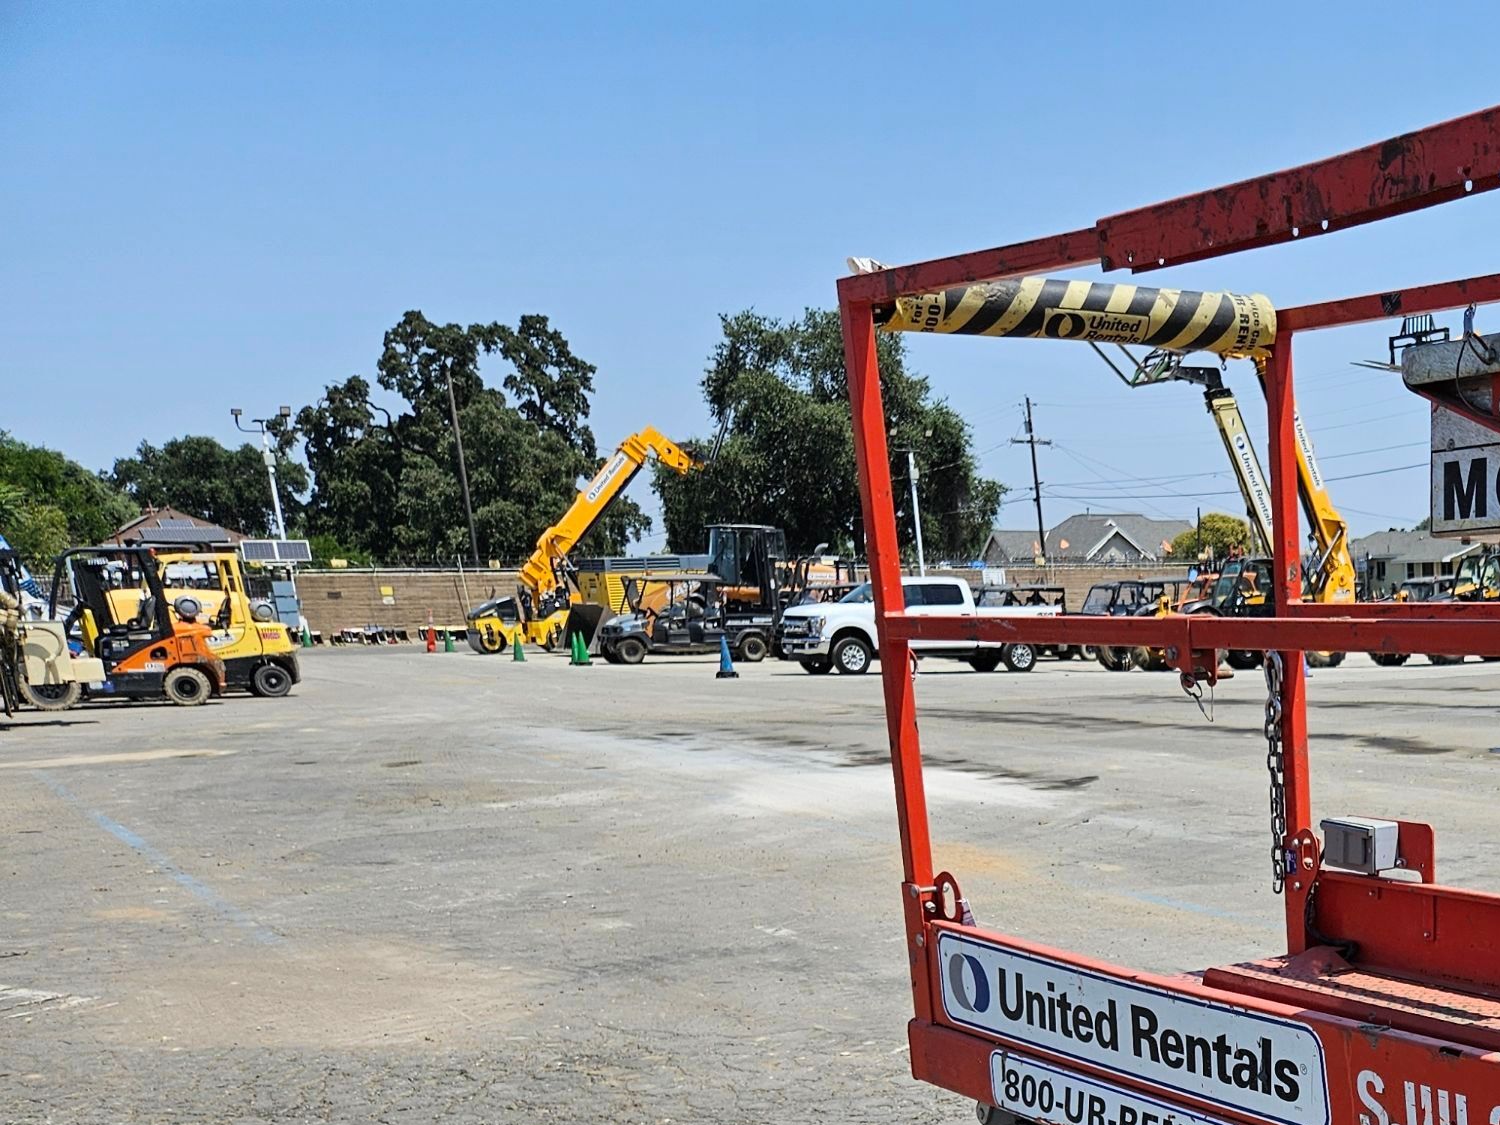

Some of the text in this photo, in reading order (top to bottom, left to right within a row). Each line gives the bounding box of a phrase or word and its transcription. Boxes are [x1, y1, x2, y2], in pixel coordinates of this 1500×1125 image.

[1090, 315, 1142, 332] United
[1296, 423, 1309, 454] United
[594, 473, 610, 495] United
[1241, 452, 1272, 527] United Rentals
[998, 967, 1301, 1103] United Rentals
